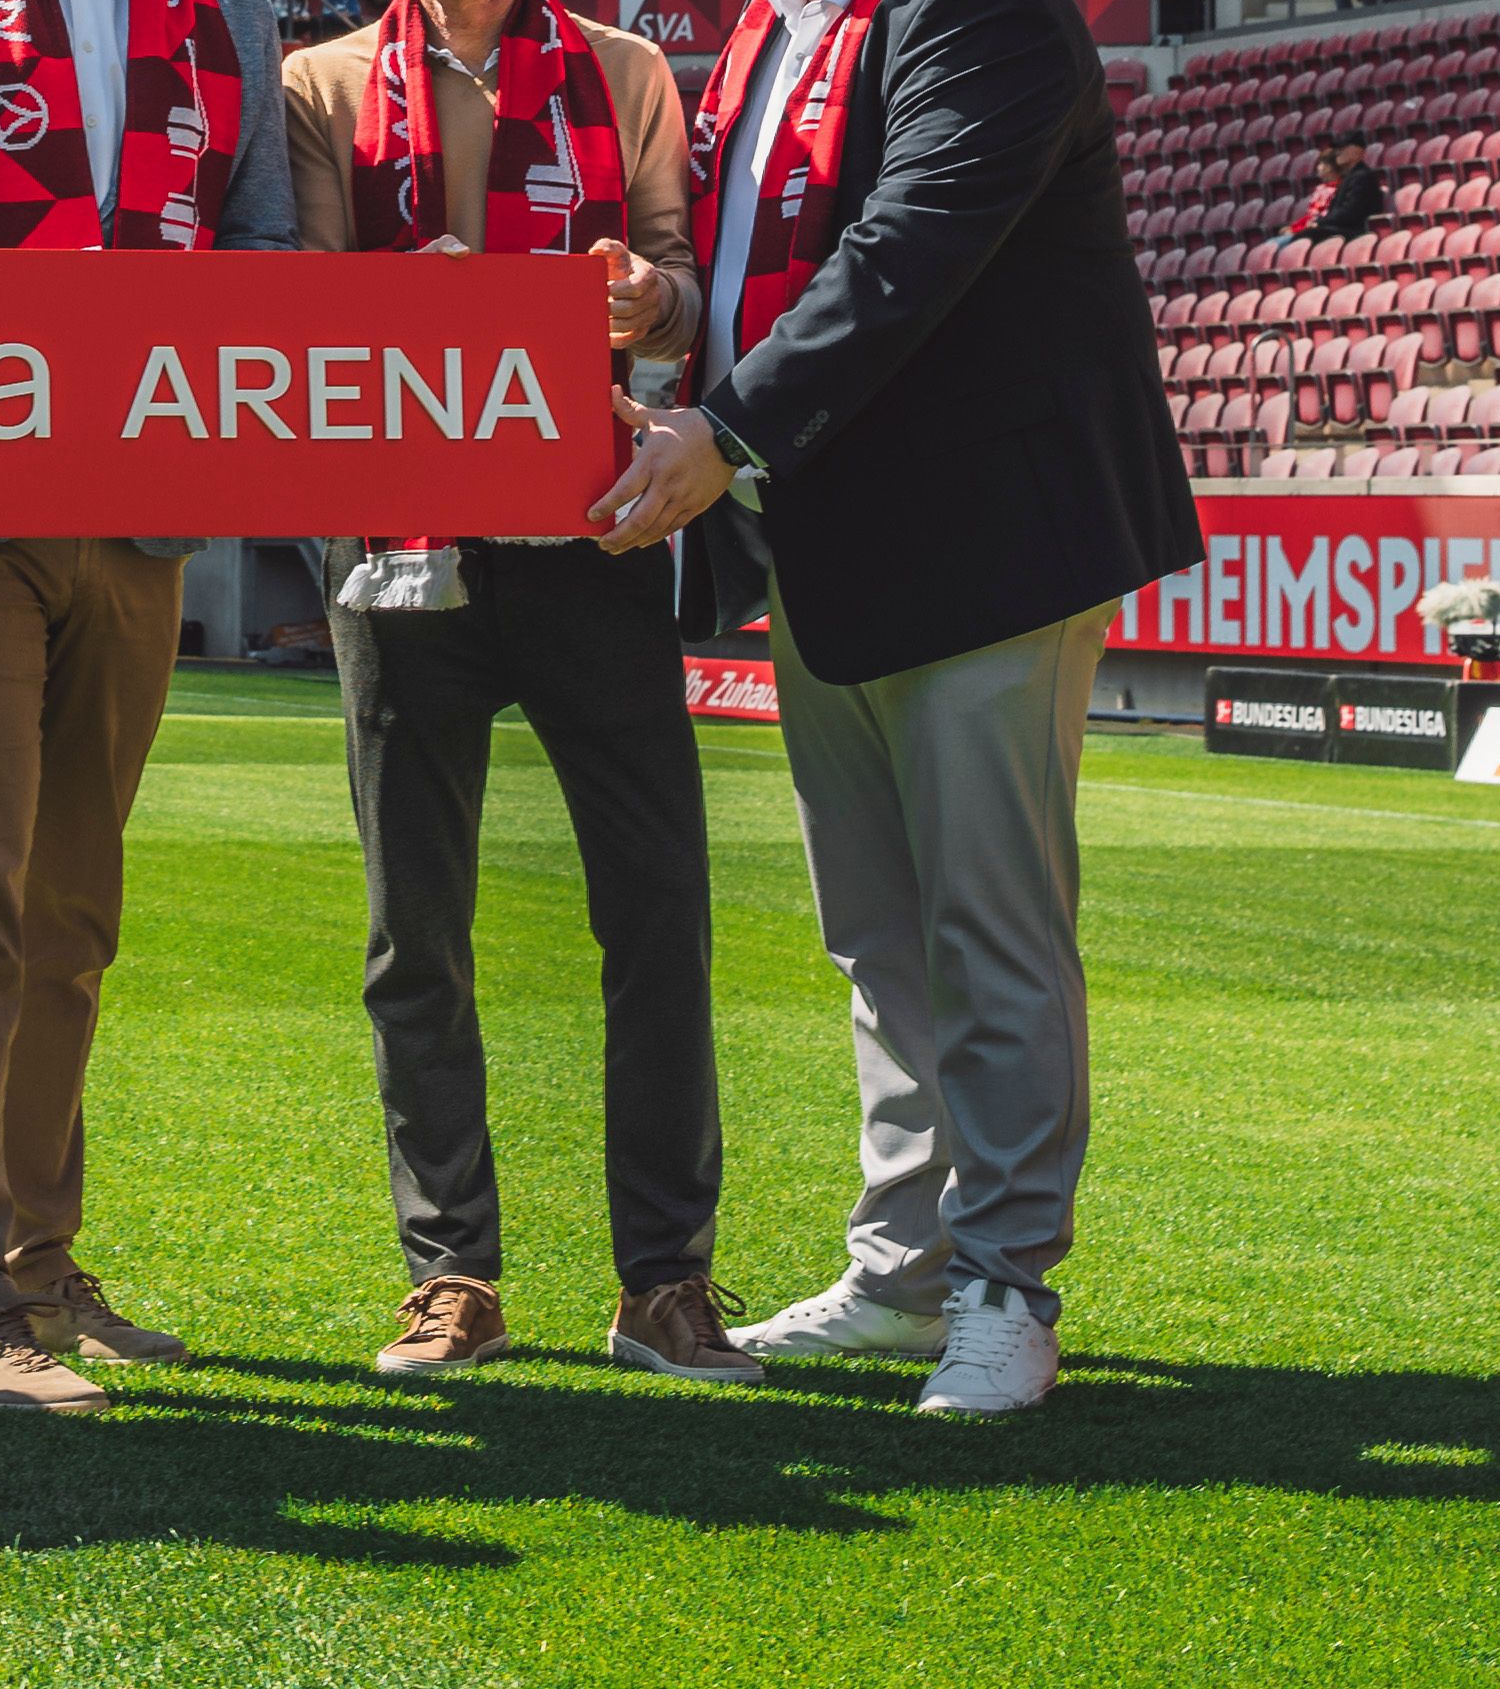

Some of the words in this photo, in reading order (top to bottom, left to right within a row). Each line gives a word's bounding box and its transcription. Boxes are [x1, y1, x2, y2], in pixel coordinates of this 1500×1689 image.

[638, 13, 694, 42] SVA
[121, 346, 560, 440] ARENA
[1232, 701, 1326, 732] BUNDESLIGA
[1354, 706, 1446, 737] BUNDESLIGA
